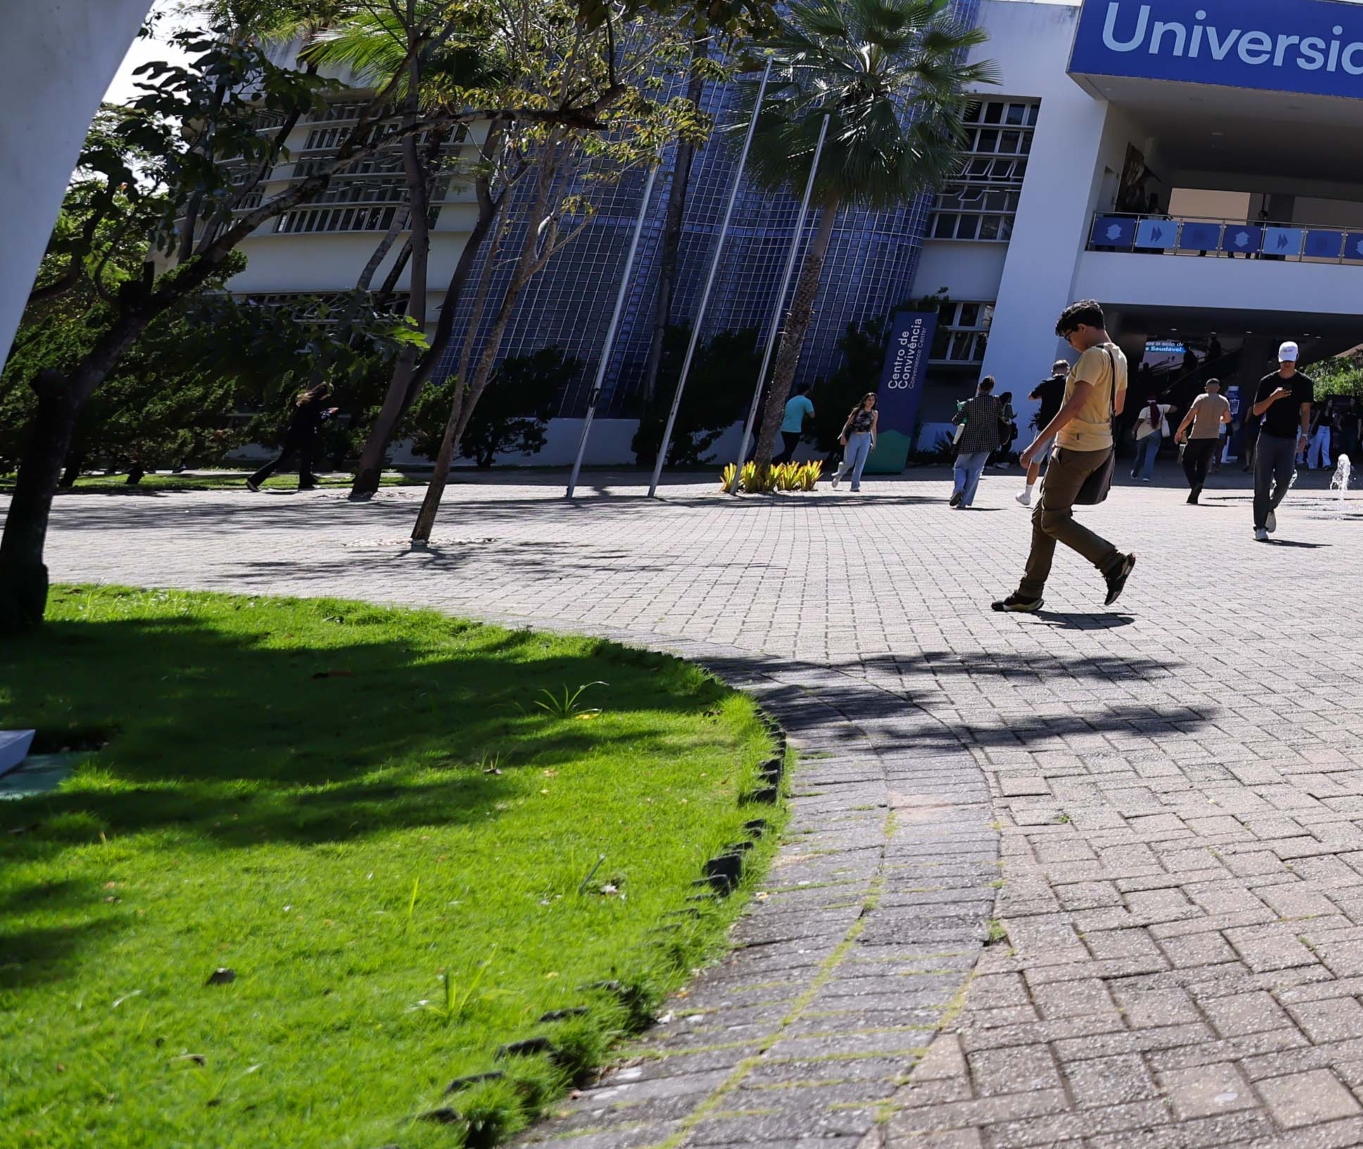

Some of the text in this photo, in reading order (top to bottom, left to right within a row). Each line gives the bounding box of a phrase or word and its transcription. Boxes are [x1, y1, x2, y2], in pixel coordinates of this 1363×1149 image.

[888, 331, 909, 389] Centro de
[898, 319, 922, 389] Convivência
[908, 327, 927, 389] Convenience Center
